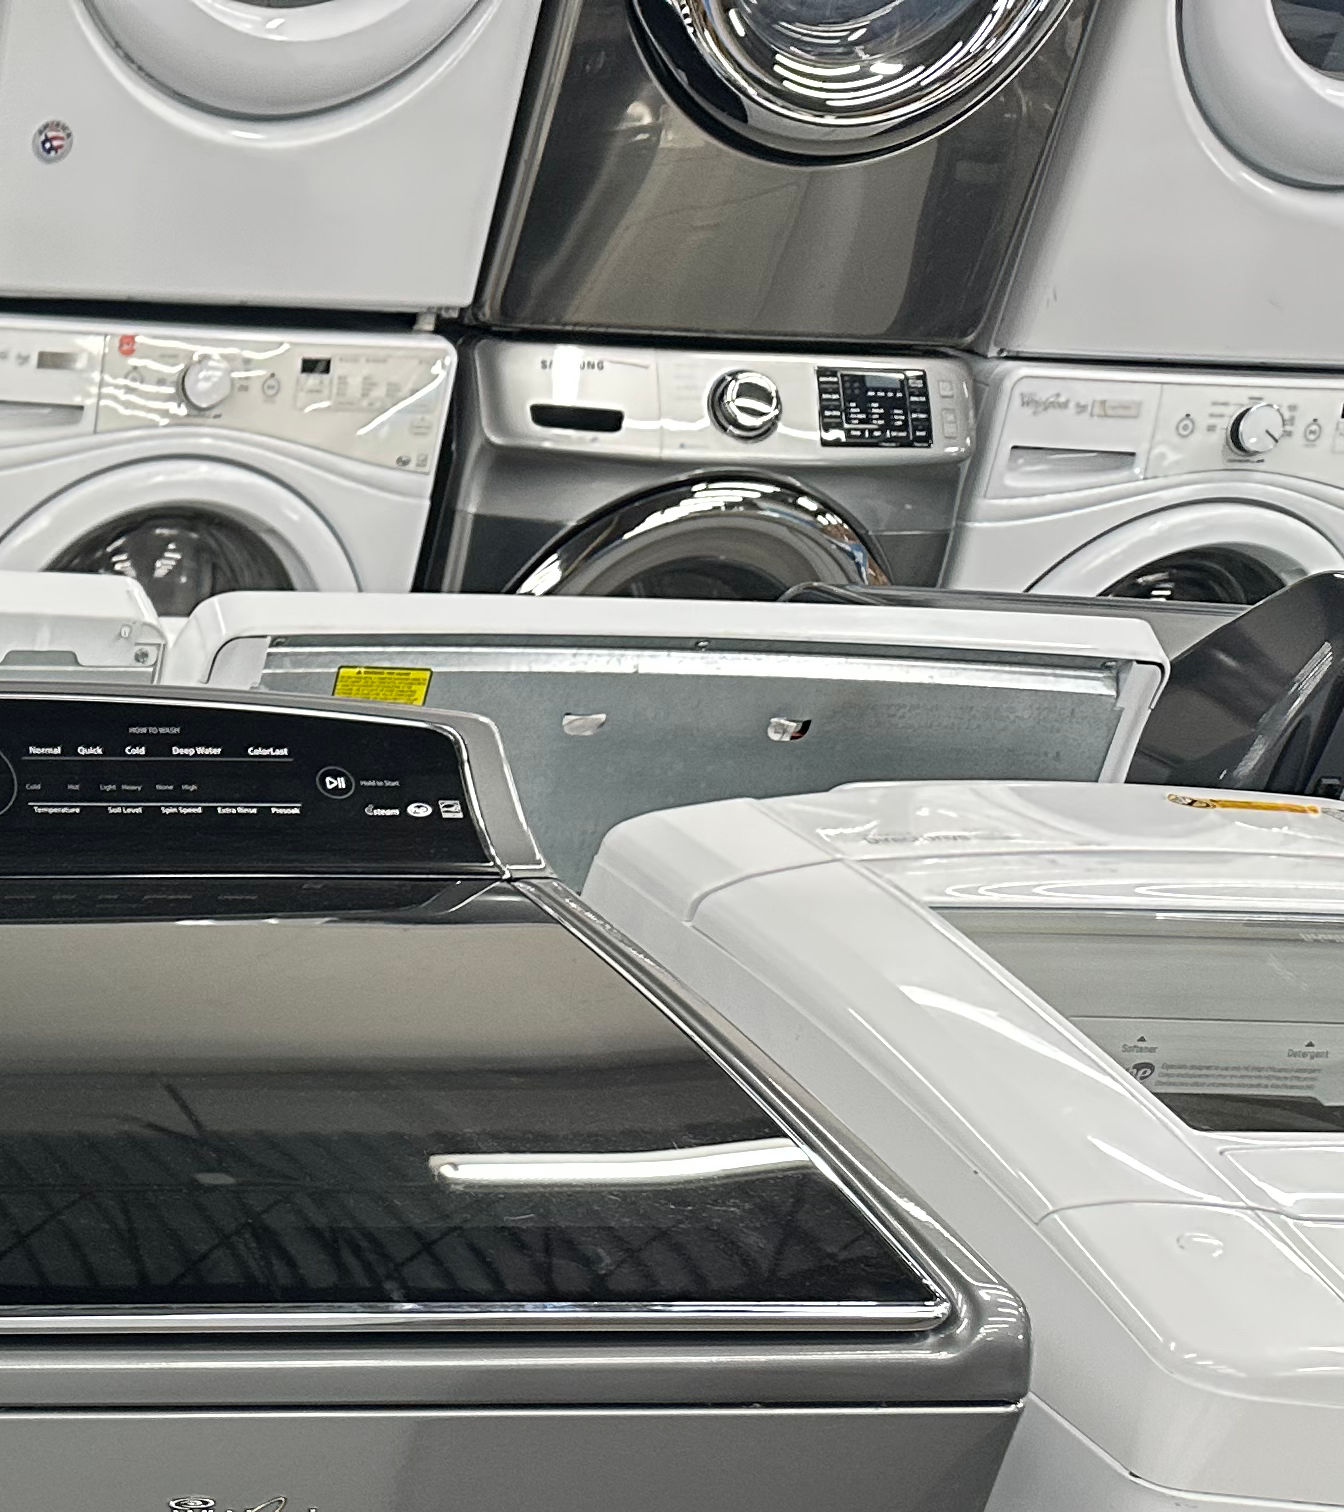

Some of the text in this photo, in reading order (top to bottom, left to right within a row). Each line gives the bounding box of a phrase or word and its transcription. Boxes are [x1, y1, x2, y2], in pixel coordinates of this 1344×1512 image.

[29, 746, 61, 755] Normal
[77, 745, 103, 756] Quick
[124, 745, 146, 755] Cold
[171, 746, 222, 757] Deep Water
[247, 746, 289, 756] ColorLast
[33, 806, 81, 816] Temperature
[108, 806, 143, 815] Soil Level
[161, 806, 203, 816] Spin Speed
[217, 806, 236, 815] Extra
[271, 807, 301, 816] Presoak
[373, 808, 400, 816] steam
[1121, 1043, 1158, 1054] Softener
[1287, 1048, 1329, 1060] Detergent
